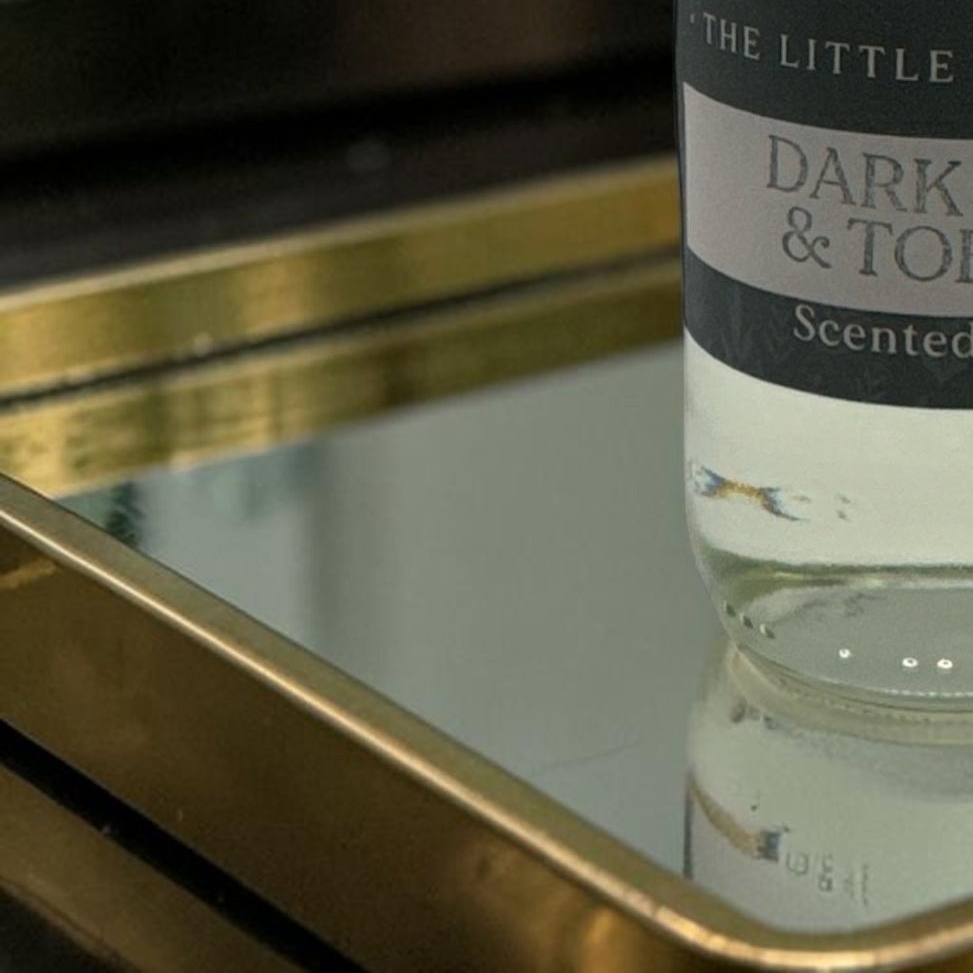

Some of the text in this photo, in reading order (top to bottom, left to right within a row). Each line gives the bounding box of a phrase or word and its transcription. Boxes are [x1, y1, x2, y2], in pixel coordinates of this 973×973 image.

[703, 12, 760, 60] THE
[779, 34, 954, 82] LITTLE
[766, 135, 963, 217] DARK
[781, 207, 832, 269] &
